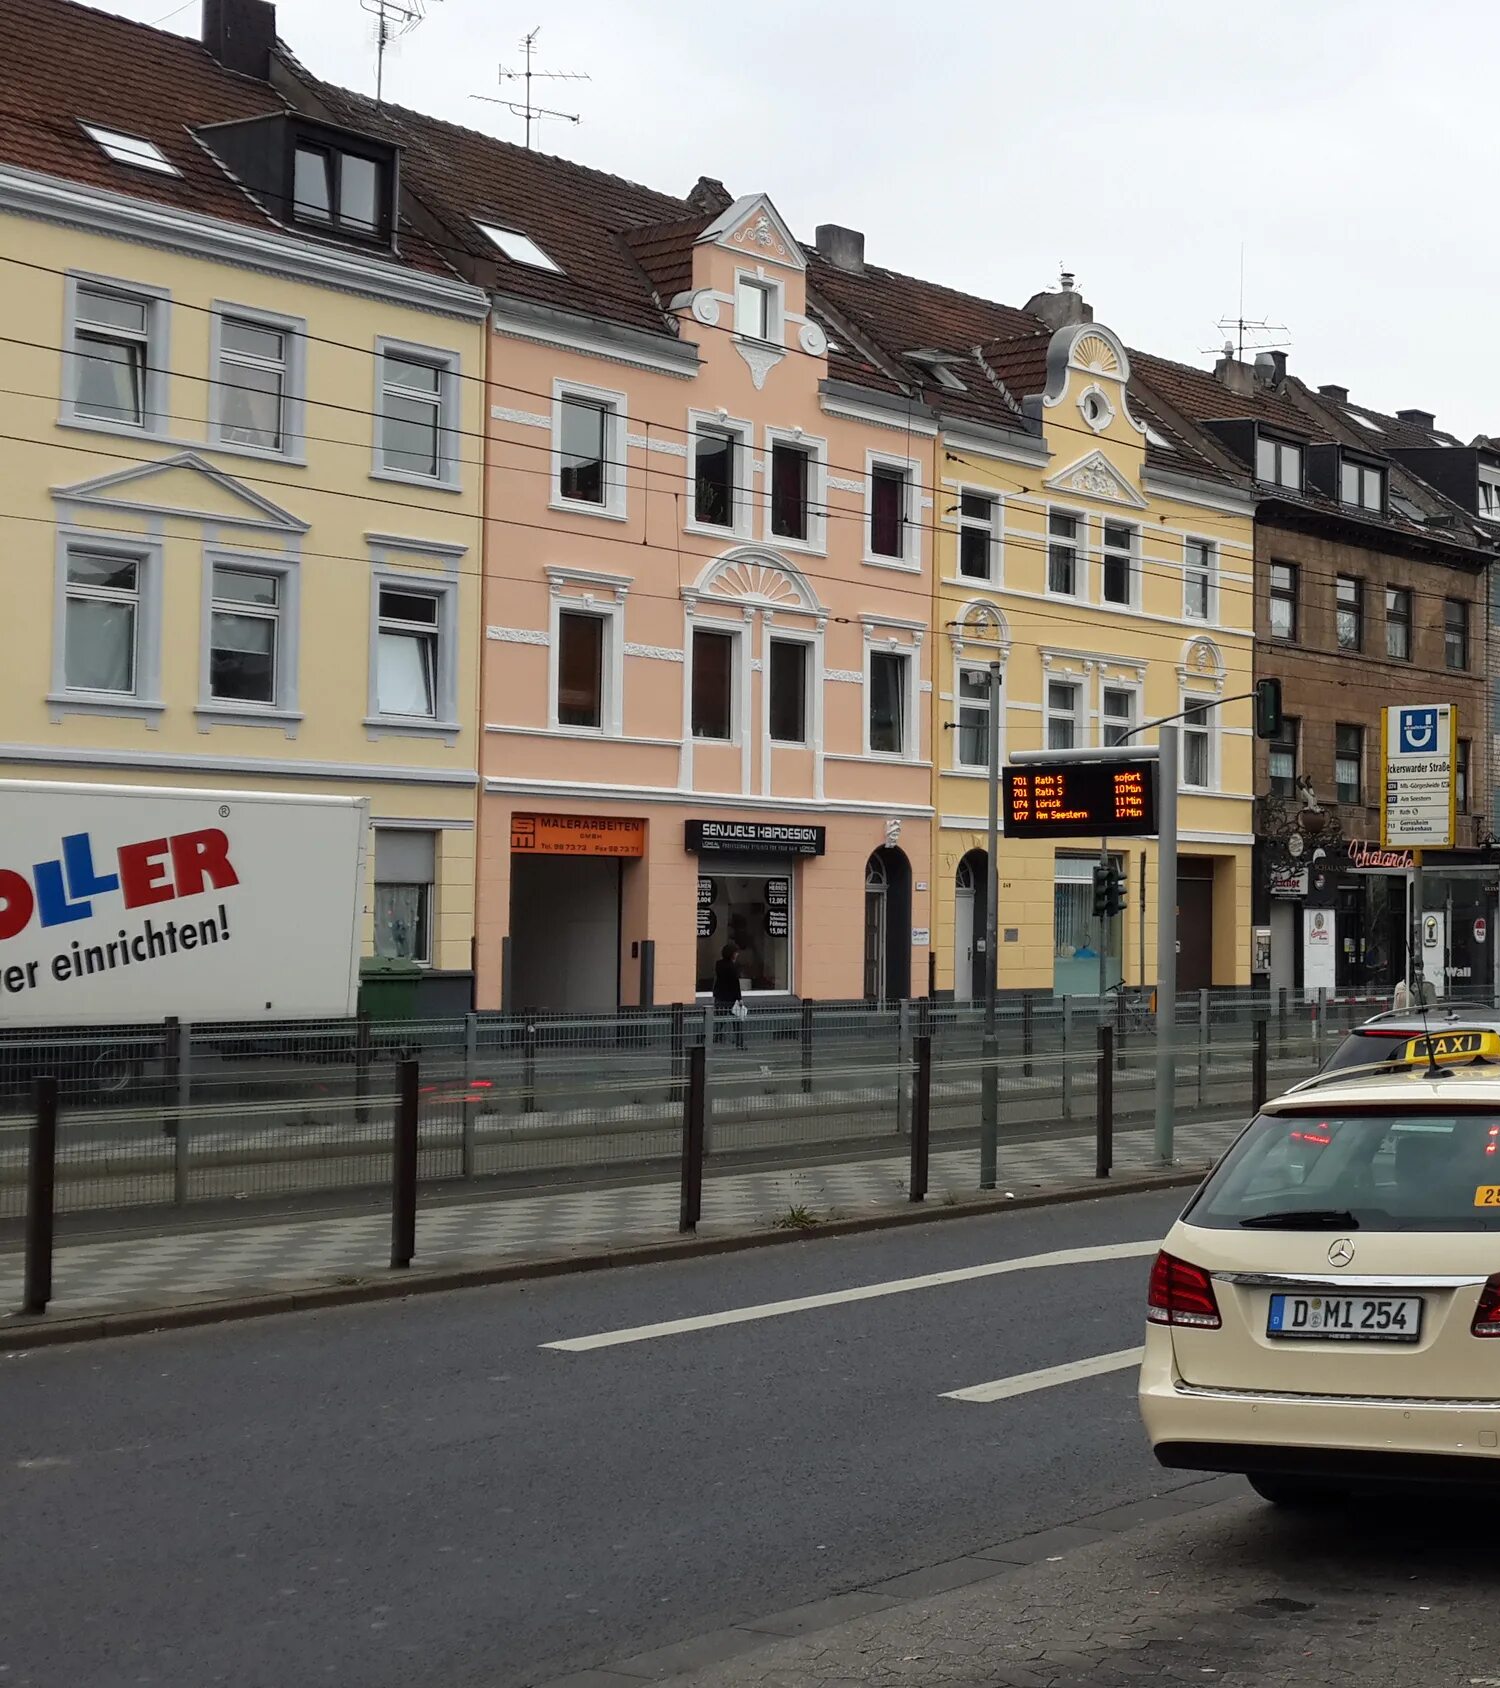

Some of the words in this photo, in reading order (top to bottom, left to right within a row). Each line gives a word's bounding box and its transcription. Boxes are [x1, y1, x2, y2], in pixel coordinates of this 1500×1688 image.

[1430, 762, 1450, 773] Straße
[1013, 777, 1027, 785] 701
[1035, 776, 1054, 785] Rath
[1057, 776, 1063, 784] S
[1114, 773, 1141, 783] sofort
[1013, 789, 1027, 797] 701
[1035, 788, 1055, 796] Rath
[1057, 788, 1063, 796] S
[1115, 786, 1125, 794] 10
[1126, 785, 1142, 793] Min
[1013, 801, 1028, 809] U74
[1036, 800, 1061, 808] Lörick
[1126, 797, 1142, 805] Min
[1013, 812, 1029, 820] U77
[1051, 811, 1088, 819] Seestern
[1116, 809, 1125, 817] 17
[1127, 809, 1142, 817] Min
[541, 819, 639, 831] MALERARBEITEN
[703, 823, 755, 838] SENJUEL'S
[0, 960, 39, 993] er
[51, 904, 230, 982] einrichten!
[1446, 967, 1472, 978] Wall
[1422, 1036, 1473, 1055] TAXI
[1292, 1301, 1308, 1327] D
[1323, 1301, 1353, 1328] MI
[1361, 1302, 1407, 1329] 254
